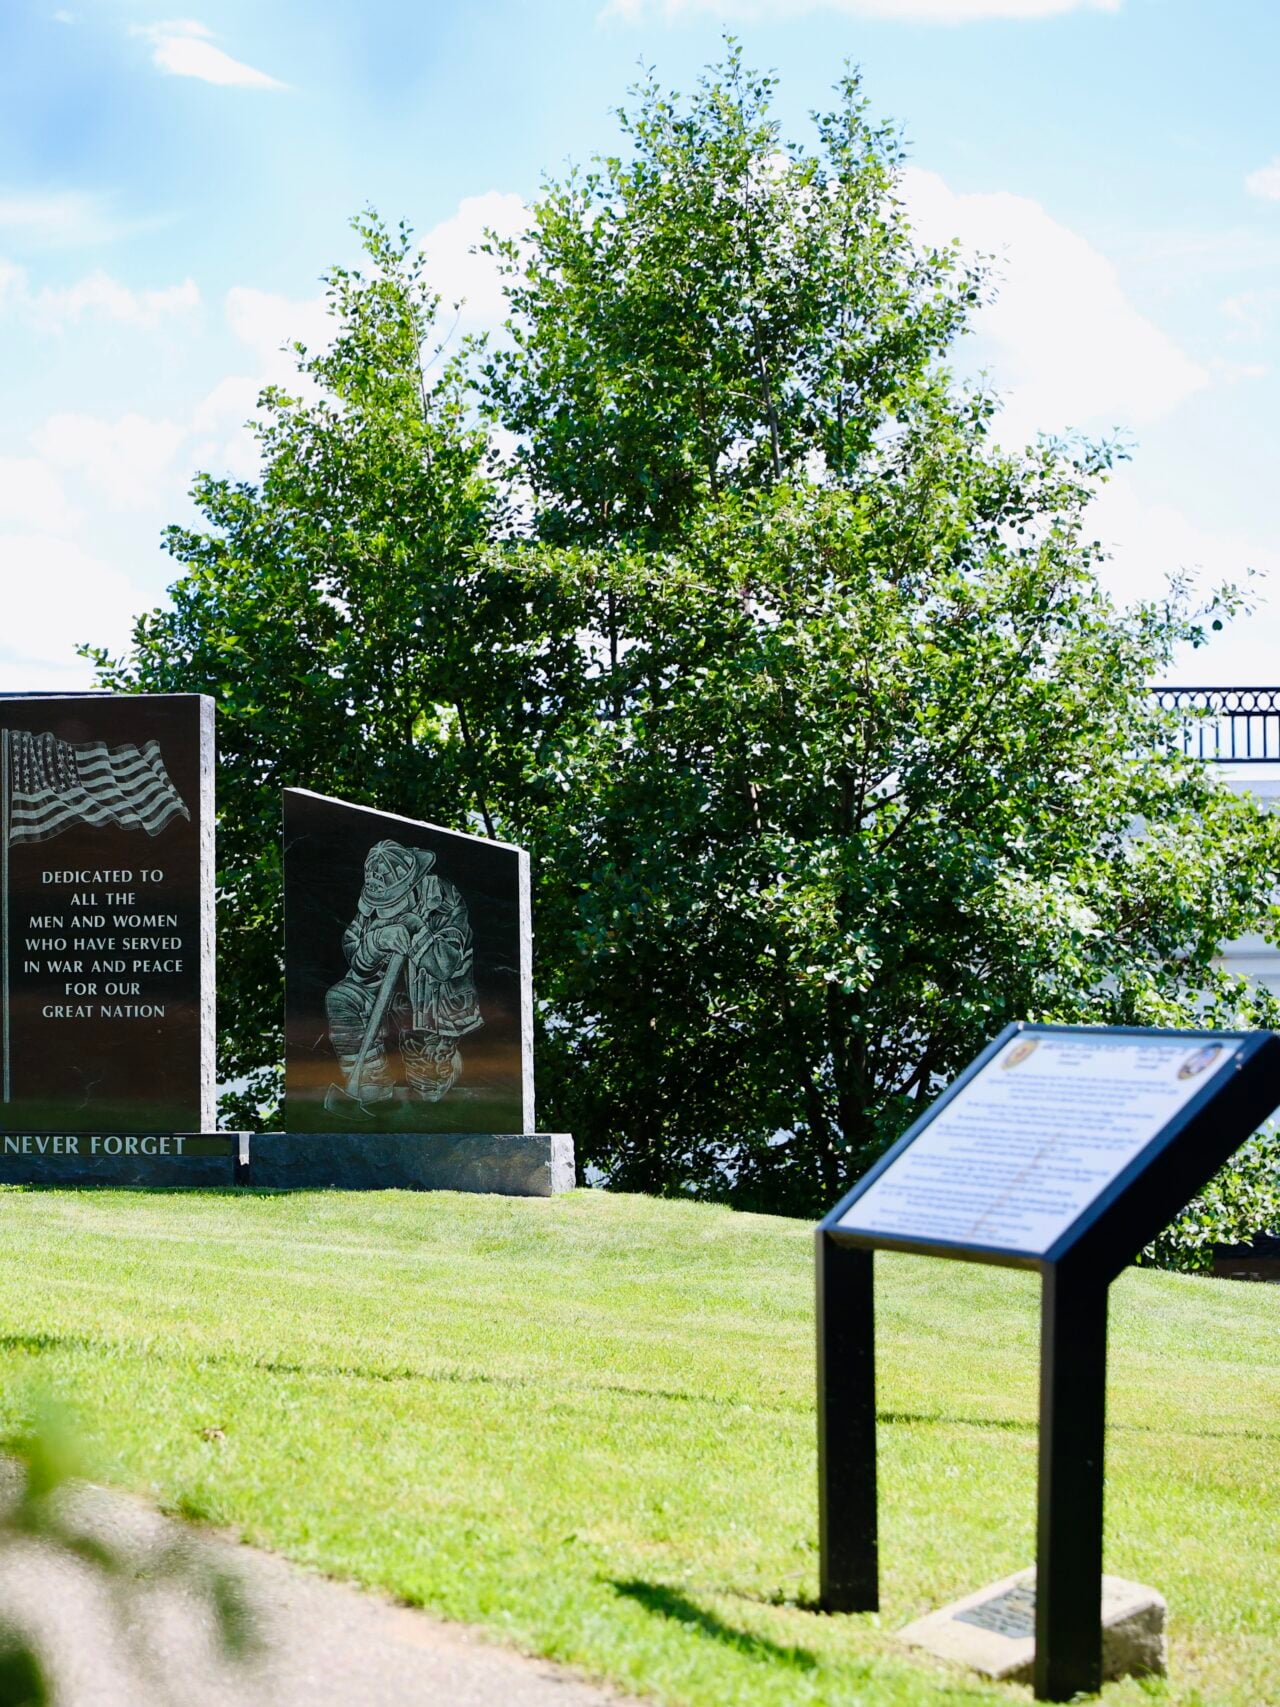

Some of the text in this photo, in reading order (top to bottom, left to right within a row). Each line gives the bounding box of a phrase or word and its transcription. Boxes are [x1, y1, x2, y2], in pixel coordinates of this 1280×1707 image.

[42, 869, 164, 884] DEDICATED TO
[70, 892, 136, 906] ALL THE
[29, 914, 178, 929] MEN AND WOMEN
[25, 937, 182, 951] WHO HAVE SERVED
[24, 959, 183, 973] IN WAR AND PEACE
[65, 982, 141, 996] FOR OUR
[42, 1004, 165, 1018] GREAT NATION
[4, 1136, 79, 1154] NEVER
[91, 1136, 186, 1155] FORGET
